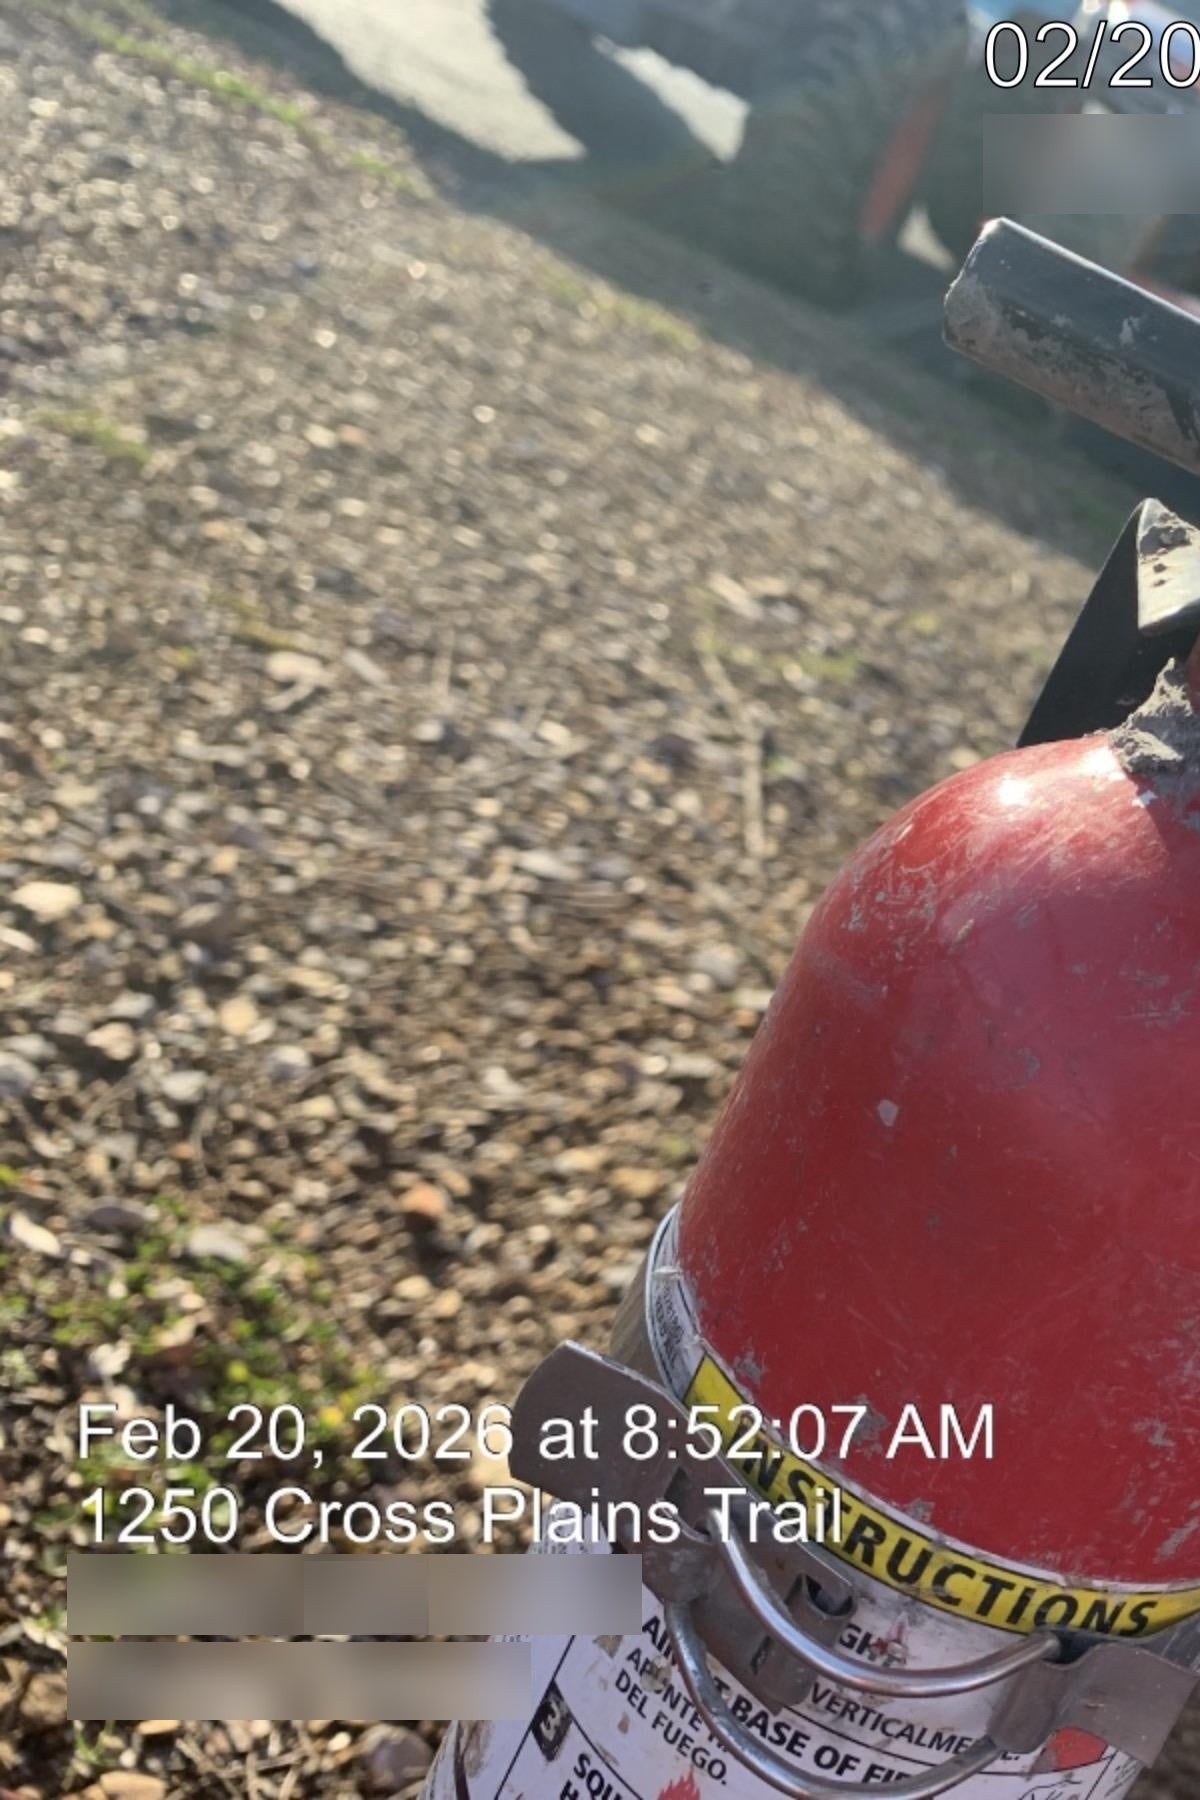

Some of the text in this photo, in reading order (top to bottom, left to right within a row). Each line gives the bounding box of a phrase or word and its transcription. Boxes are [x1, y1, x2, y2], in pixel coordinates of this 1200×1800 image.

[614, 1667, 728, 1787] DEL FUEGO.
[626, 1647, 704, 1732] APNTE
[811, 1681, 1020, 1762] VERTICALME.
[730, 1693, 811, 1759] BASE
[813, 1744, 857, 1778] OF
